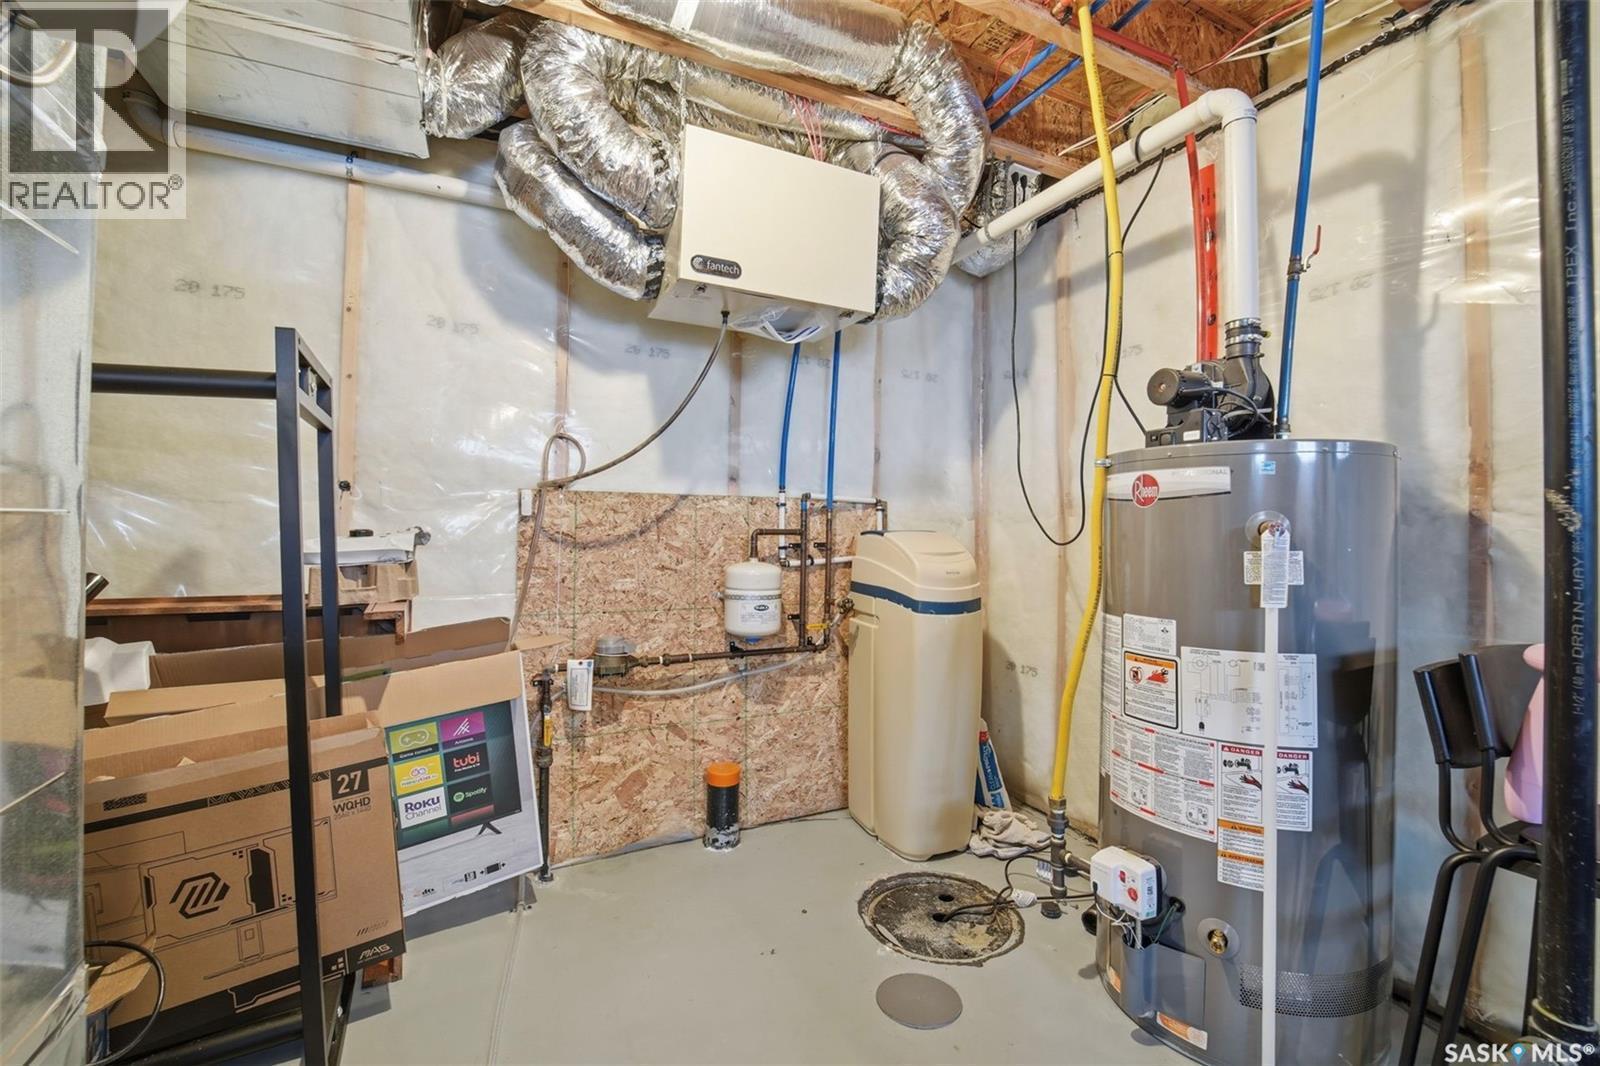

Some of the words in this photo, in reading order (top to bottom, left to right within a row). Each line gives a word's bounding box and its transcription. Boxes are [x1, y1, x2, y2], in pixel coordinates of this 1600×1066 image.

[706, 259, 740, 276] fantech
[1565, 245, 1578, 287] IPEX
[211, 284, 246, 300] 175
[1134, 475, 1158, 503] Rheem
[1571, 557, 1585, 658] DRAIN-WAY
[1019, 664, 1039, 678] 175
[1230, 747, 1261, 756] DANGER
[1278, 752, 1308, 760] DANGER
[453, 752, 480, 768] tubi
[336, 770, 362, 795] 27
[465, 786, 487, 798] Spotify
[333, 797, 371, 814] WQHD
[404, 796, 440, 813] Roku
[404, 805, 442, 820] Channel
